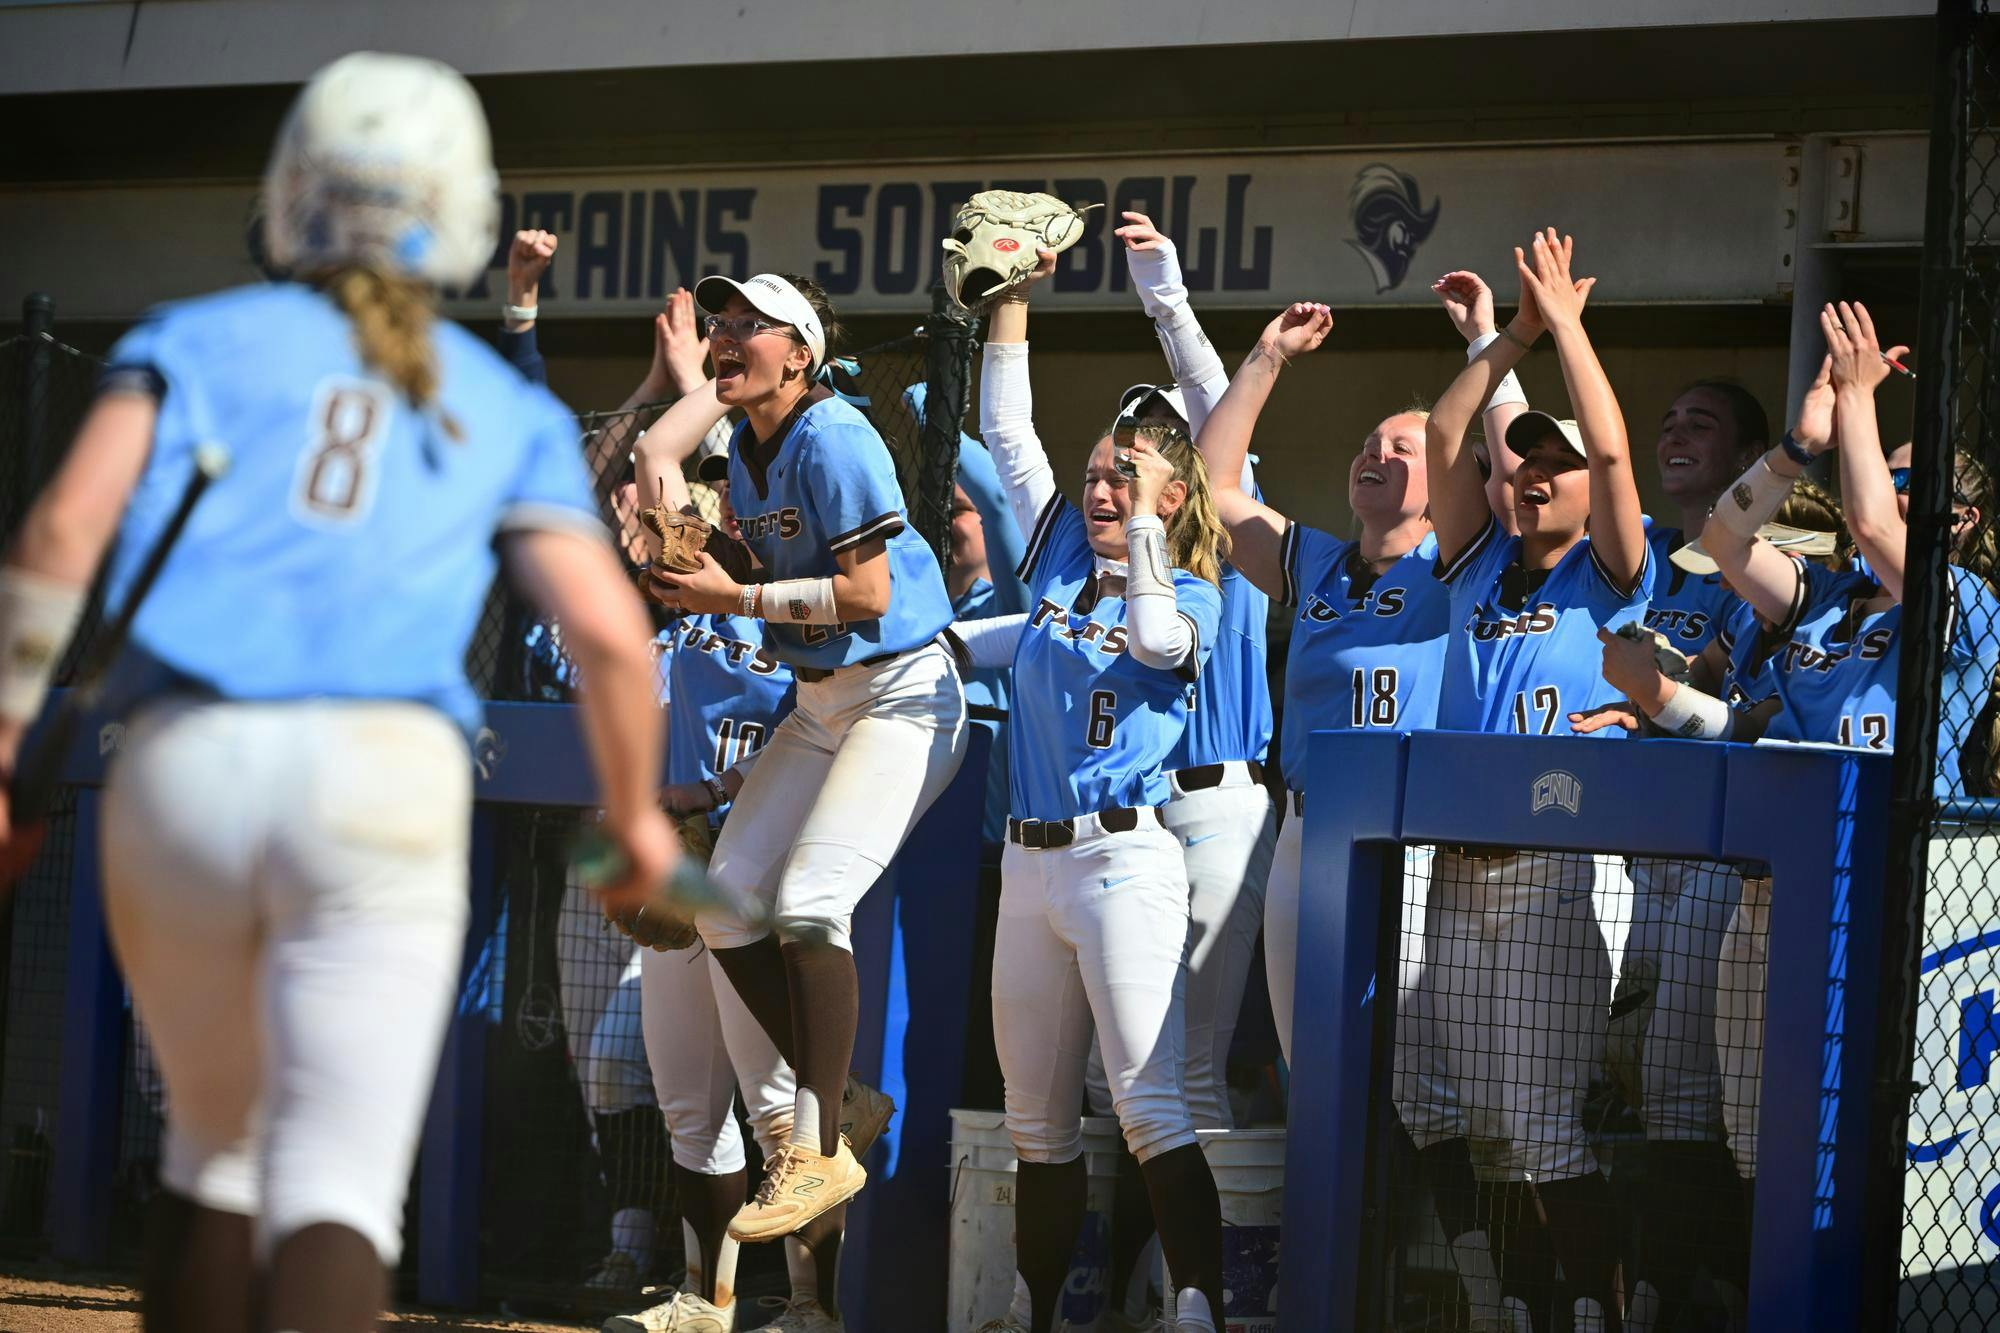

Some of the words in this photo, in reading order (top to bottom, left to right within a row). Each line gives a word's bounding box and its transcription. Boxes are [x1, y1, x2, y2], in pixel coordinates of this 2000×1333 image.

[445, 188, 757, 298] TAINS
[816, 174, 1274, 297] SOBALL
[298, 380, 387, 522] 8
[1086, 689, 1117, 749] 6
[1352, 667, 1399, 728] 18
[1532, 771, 1582, 815] CNU
